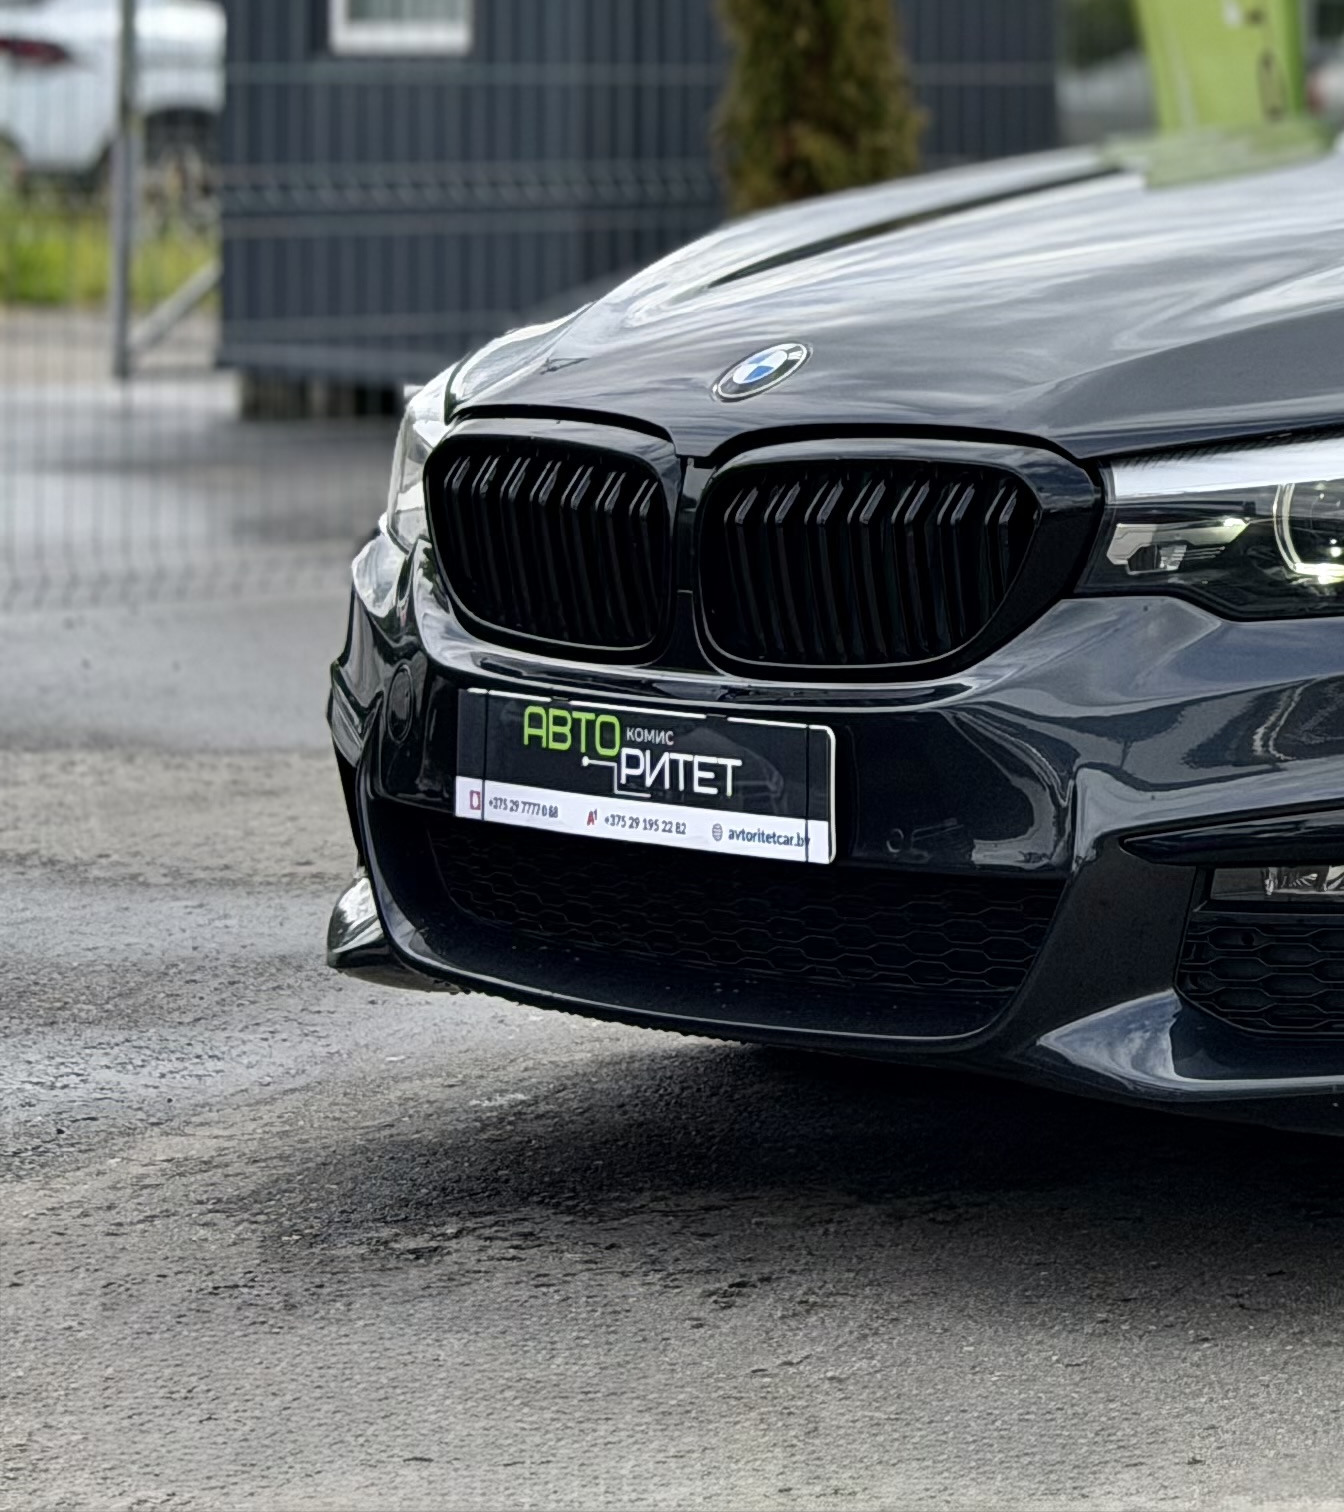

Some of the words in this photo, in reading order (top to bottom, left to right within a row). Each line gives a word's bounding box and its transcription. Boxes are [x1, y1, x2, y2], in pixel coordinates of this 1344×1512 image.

[523, 705, 621, 756] АВТО
[626, 727, 674, 745] КОМИС
[620, 747, 743, 797] РИТЕТ
